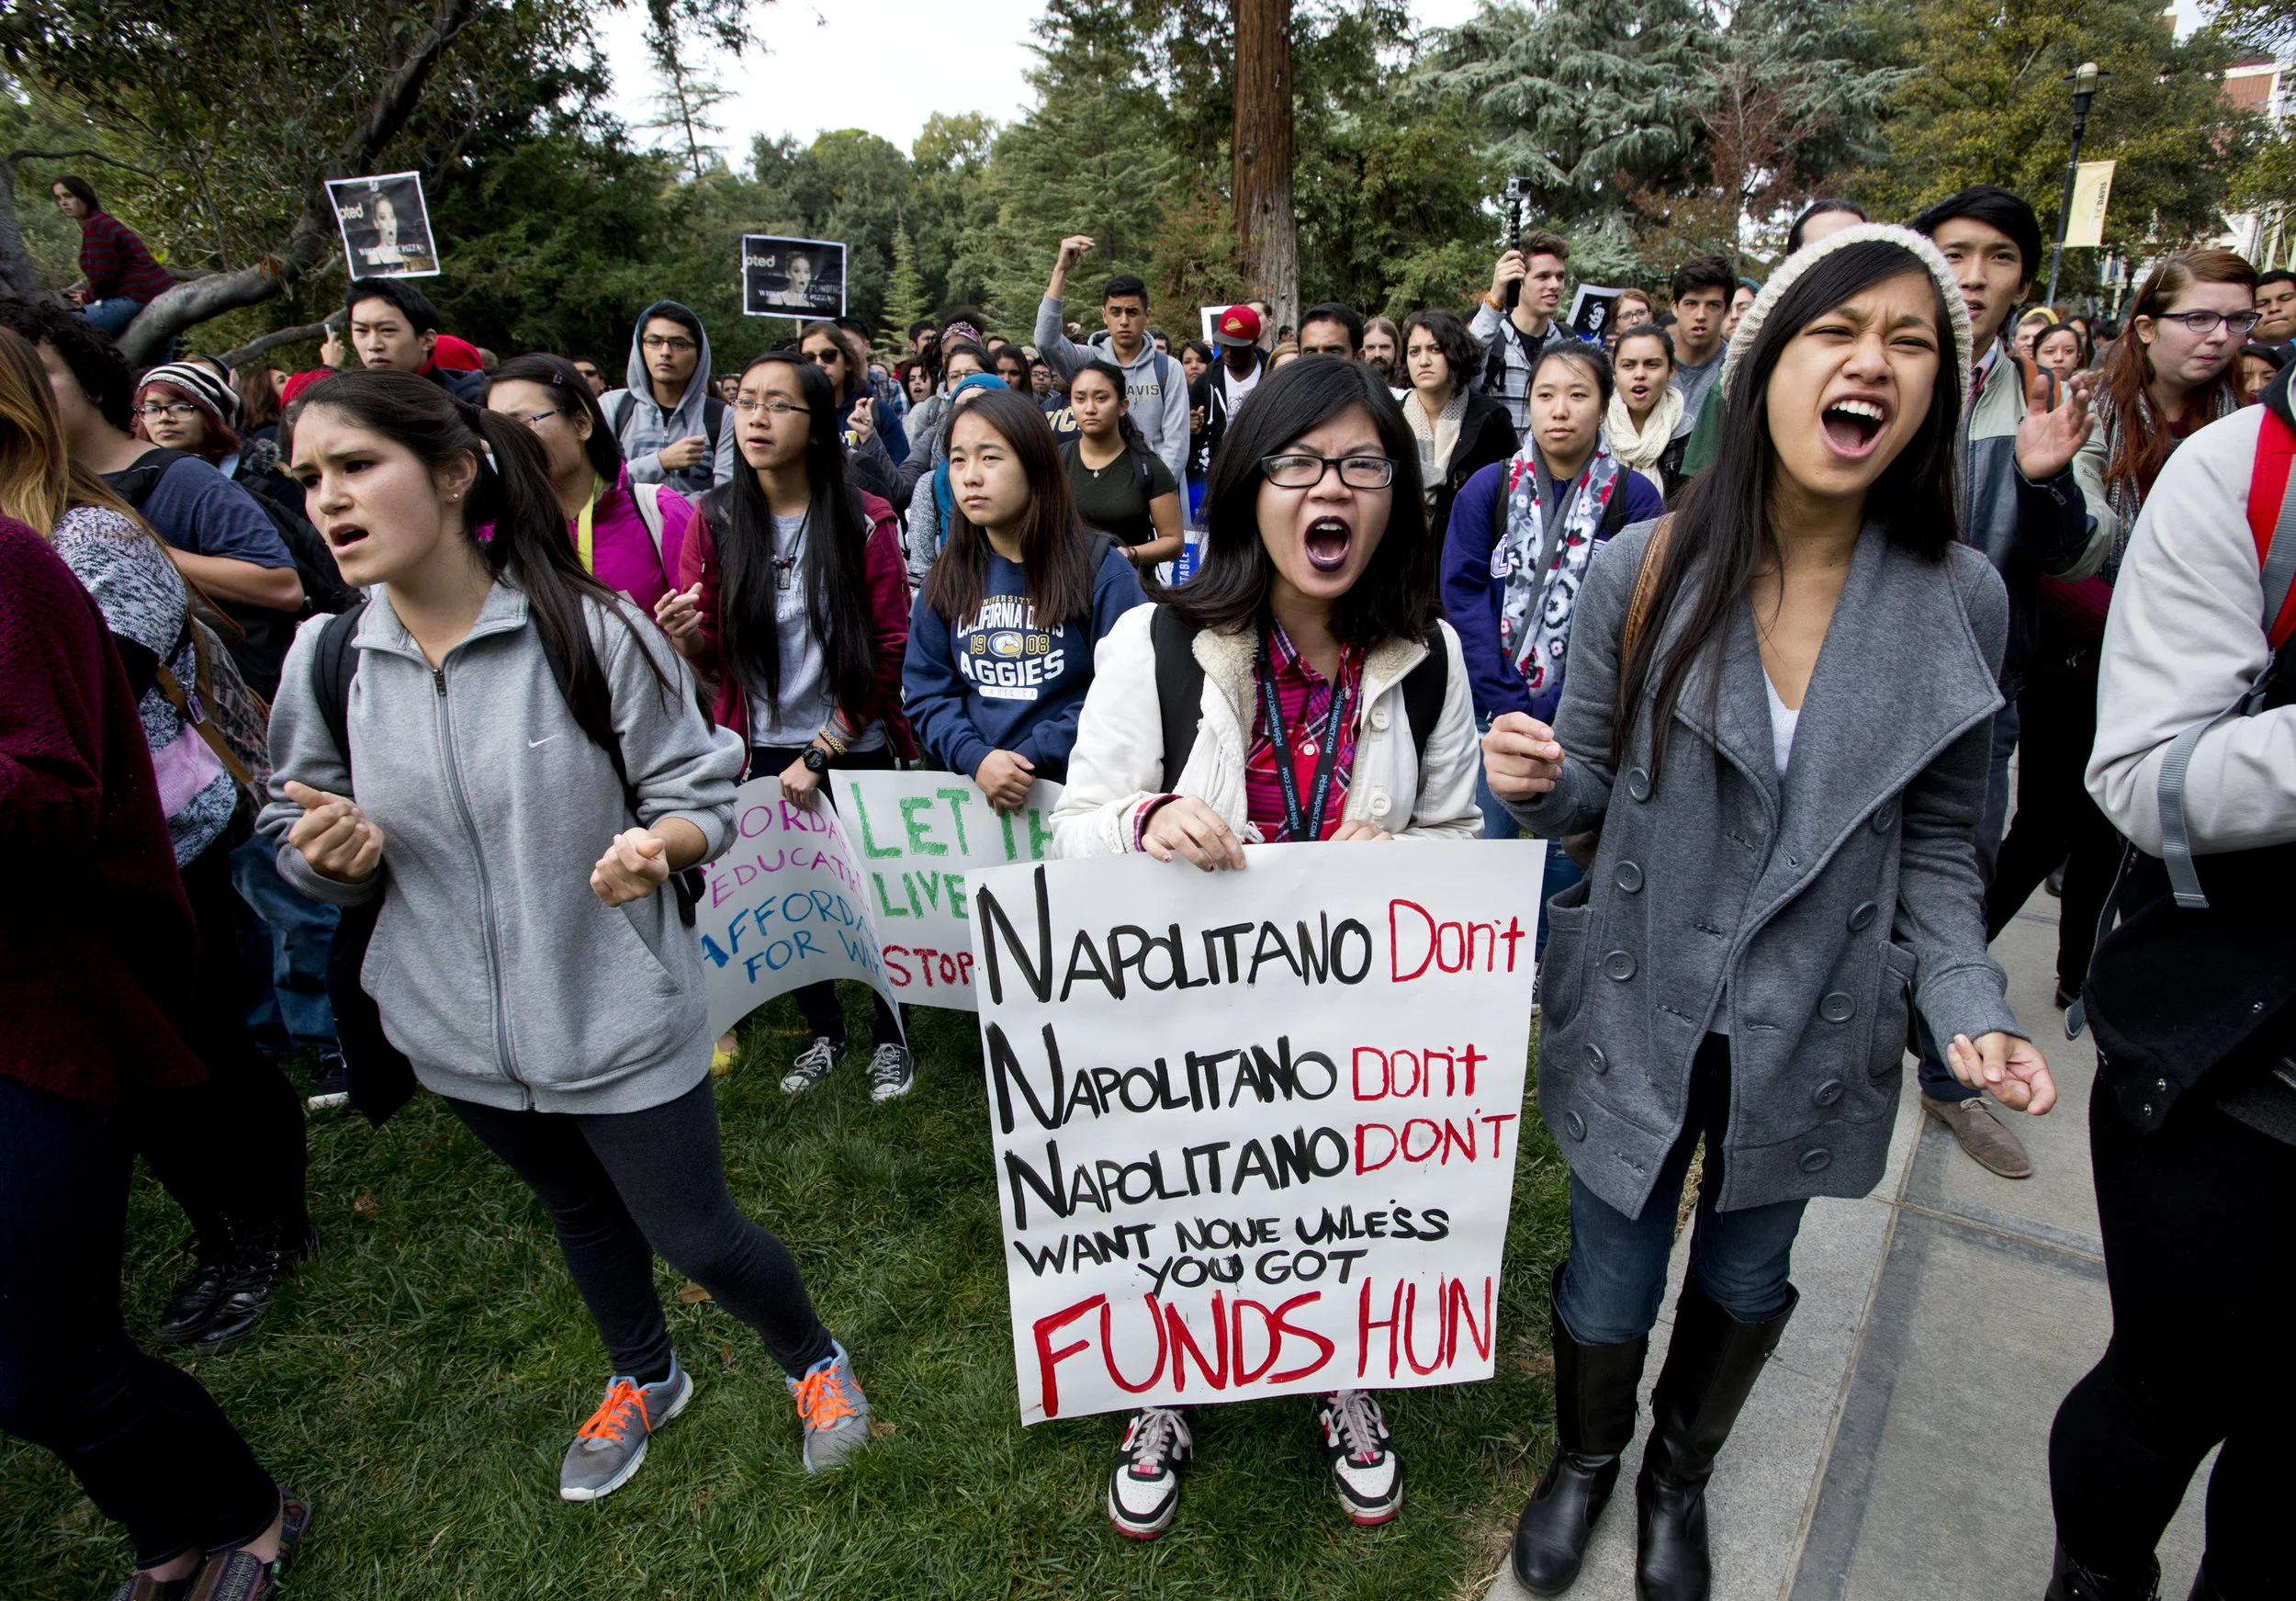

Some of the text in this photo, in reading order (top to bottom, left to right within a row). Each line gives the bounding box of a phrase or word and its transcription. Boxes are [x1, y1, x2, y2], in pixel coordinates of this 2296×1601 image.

[1127, 384, 1160, 396] AVIS
[1179, 551, 1189, 585] TABLE
[980, 594, 1032, 606] NIVERSITY
[960, 648, 1065, 688] AGGIES
[970, 634, 1050, 655] 19 08
[850, 781, 1054, 862] LET TH
[742, 930, 827, 985] FOR
[975, 863, 1525, 1006] NAPOLITANO Don't
[883, 944, 974, 988] STOP
[985, 1020, 1338, 1135] NAPOLITANO
[1003, 1108, 1518, 1231] NAPOLITANO DON'T
[1013, 1223, 1156, 1278] WANT
[1174, 1216, 1281, 1254] NONE
[1137, 1248, 1369, 1300] YOU GOT
[1032, 1272, 1492, 1418] FUNDS HUN
